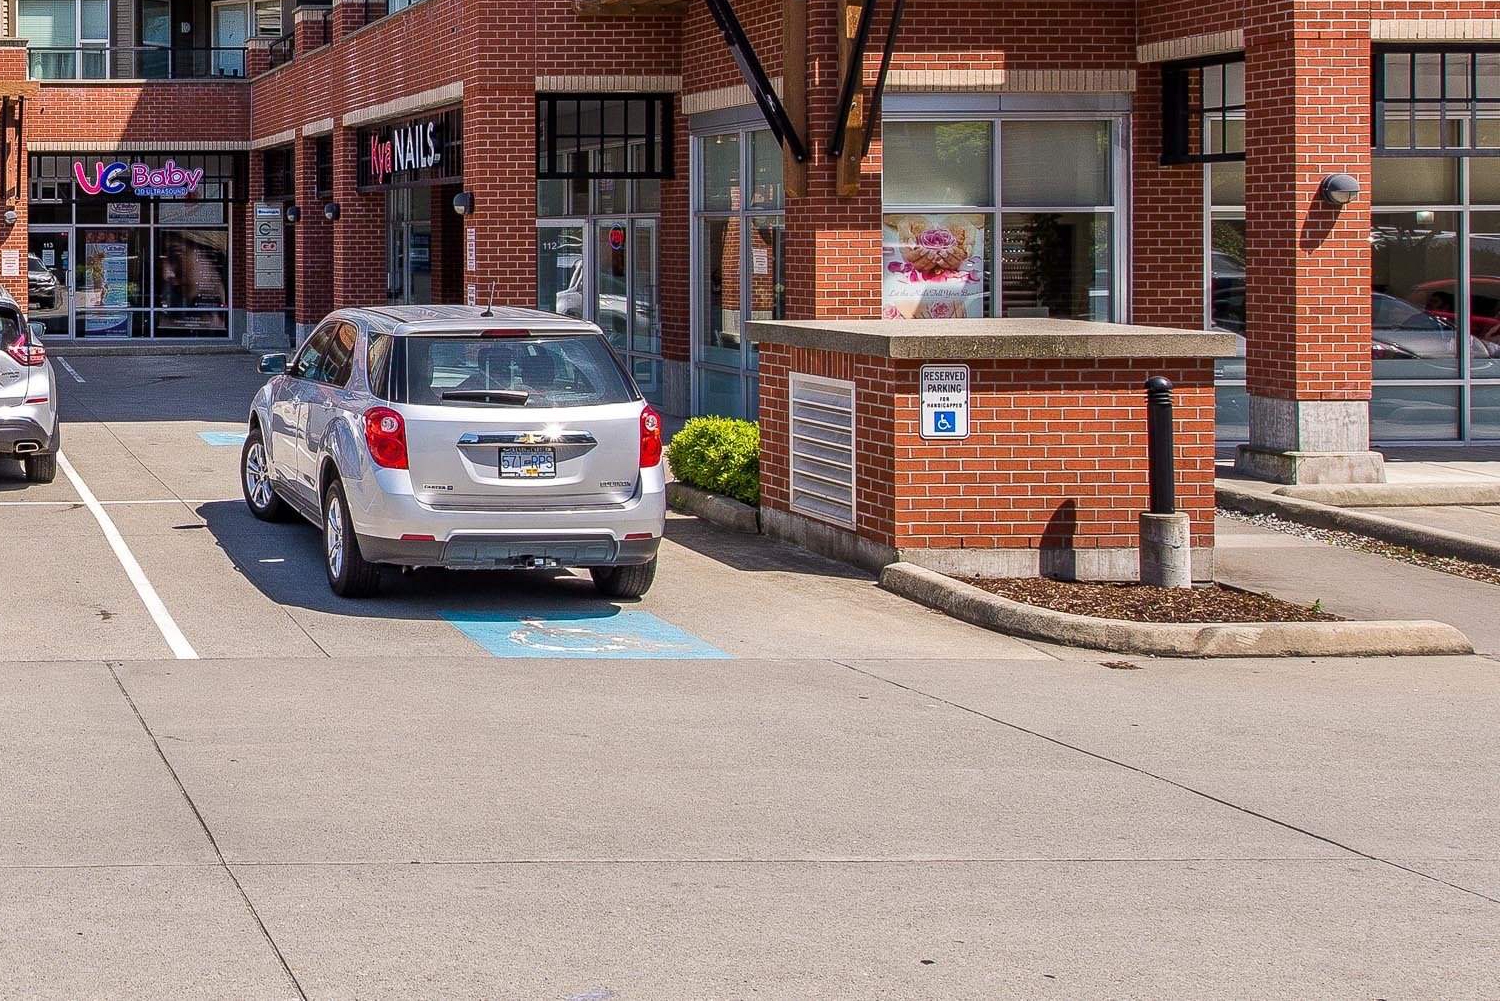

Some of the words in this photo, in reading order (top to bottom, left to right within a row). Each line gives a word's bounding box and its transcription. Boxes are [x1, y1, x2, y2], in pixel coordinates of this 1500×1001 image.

[371, 135, 392, 184] Kya
[394, 121, 435, 172] NAILS
[74, 161, 128, 194] UC
[131, 159, 203, 190] Baby
[146, 187, 187, 195] ULTRASOUND
[543, 242, 557, 250] 112
[924, 371, 966, 381] RESERVED
[928, 384, 962, 393] PARKING
[502, 455, 522, 469] 571
[531, 455, 554, 469] RPS
